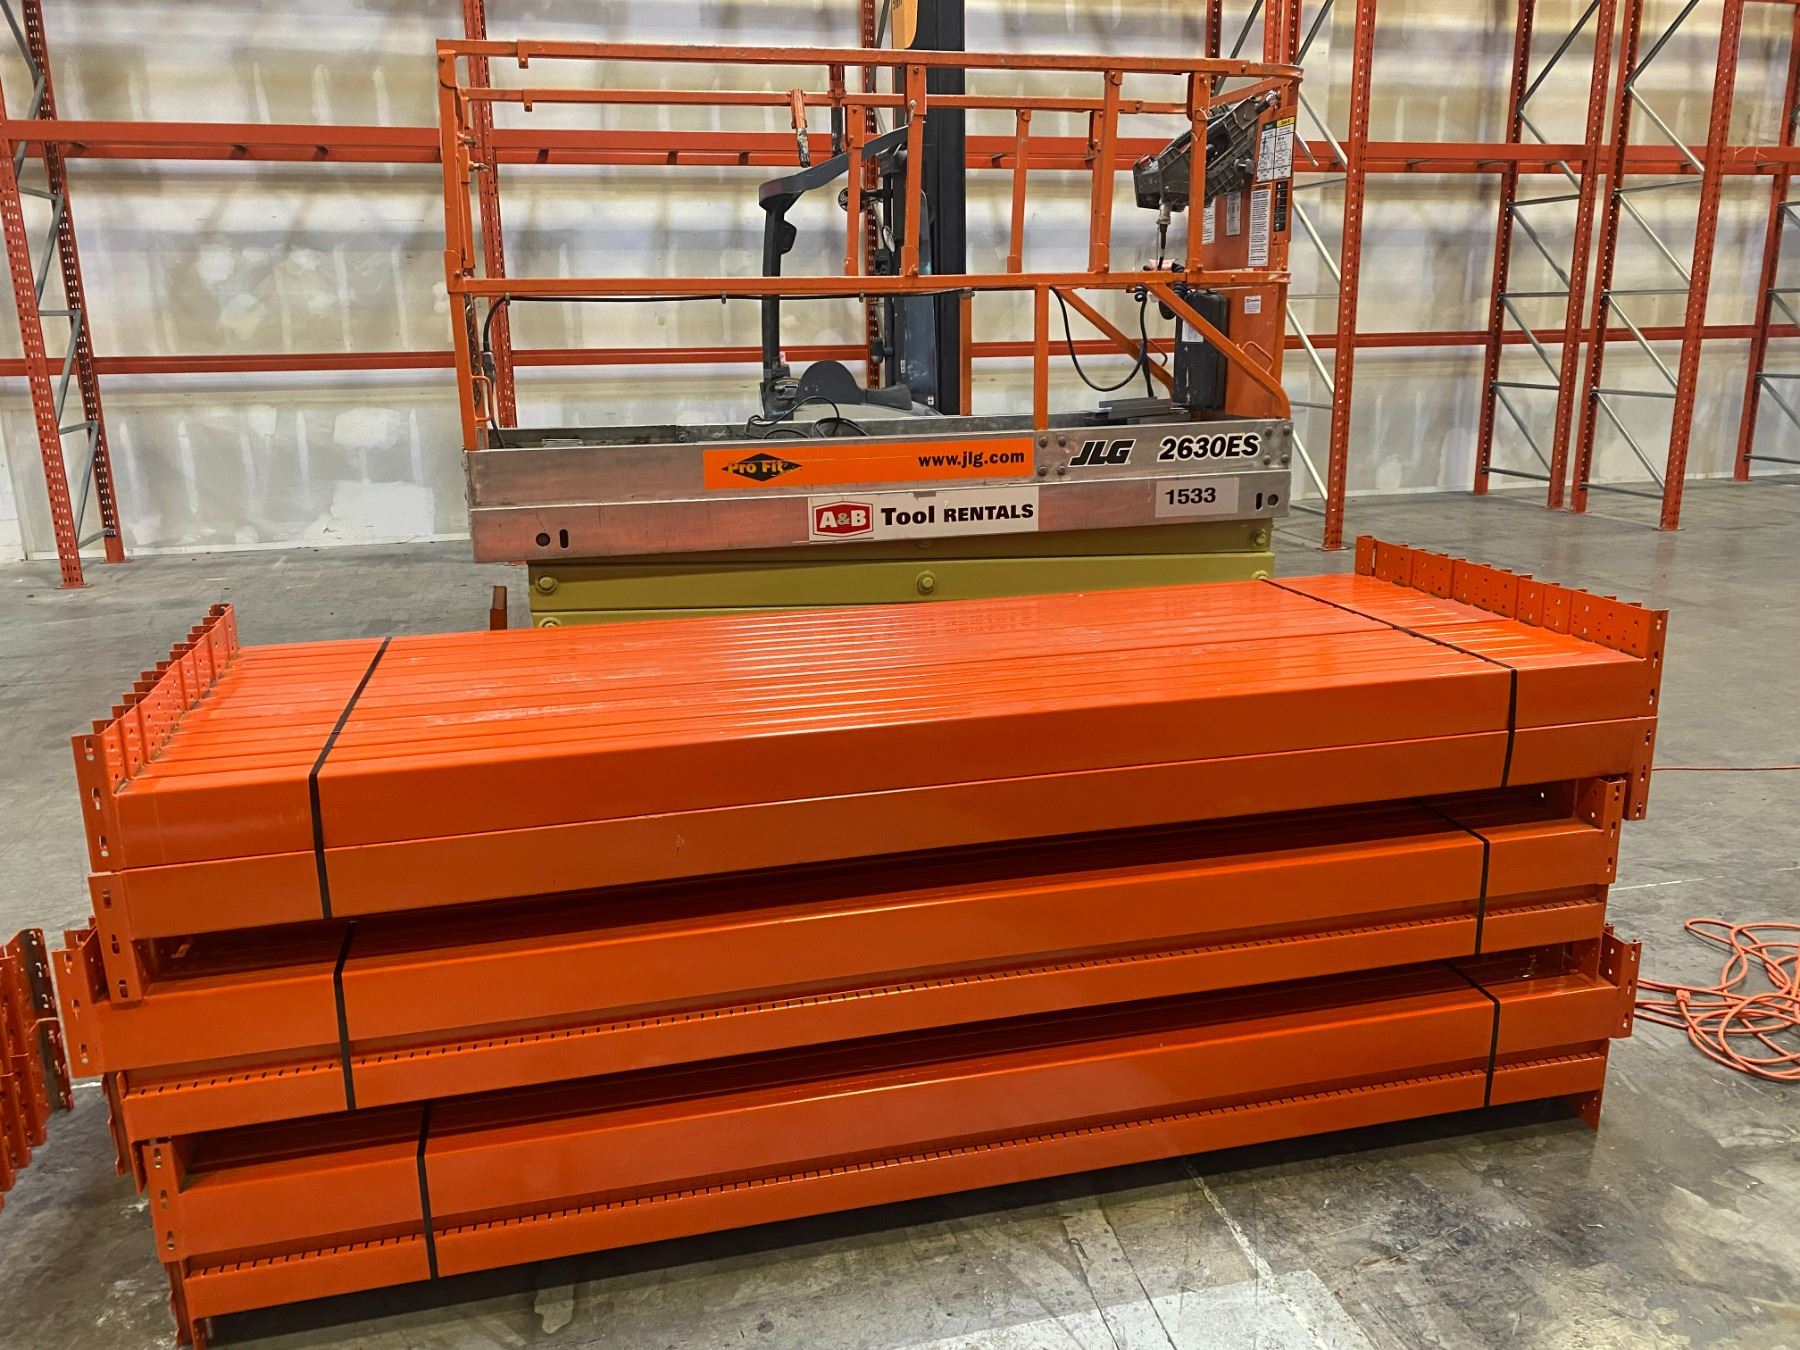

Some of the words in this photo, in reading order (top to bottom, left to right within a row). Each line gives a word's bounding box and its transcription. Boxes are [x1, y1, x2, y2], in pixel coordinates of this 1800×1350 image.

[1069, 439, 1135, 466] JLG
[1158, 434, 1260, 461] 2630ES
[727, 463, 757, 474] Pro
[918, 451, 1025, 468] www.jlg.com
[1165, 487, 1217, 505] 1533
[819, 508, 867, 529] A&B
[881, 505, 935, 526] Tool
[943, 503, 1034, 523] RENTALS
